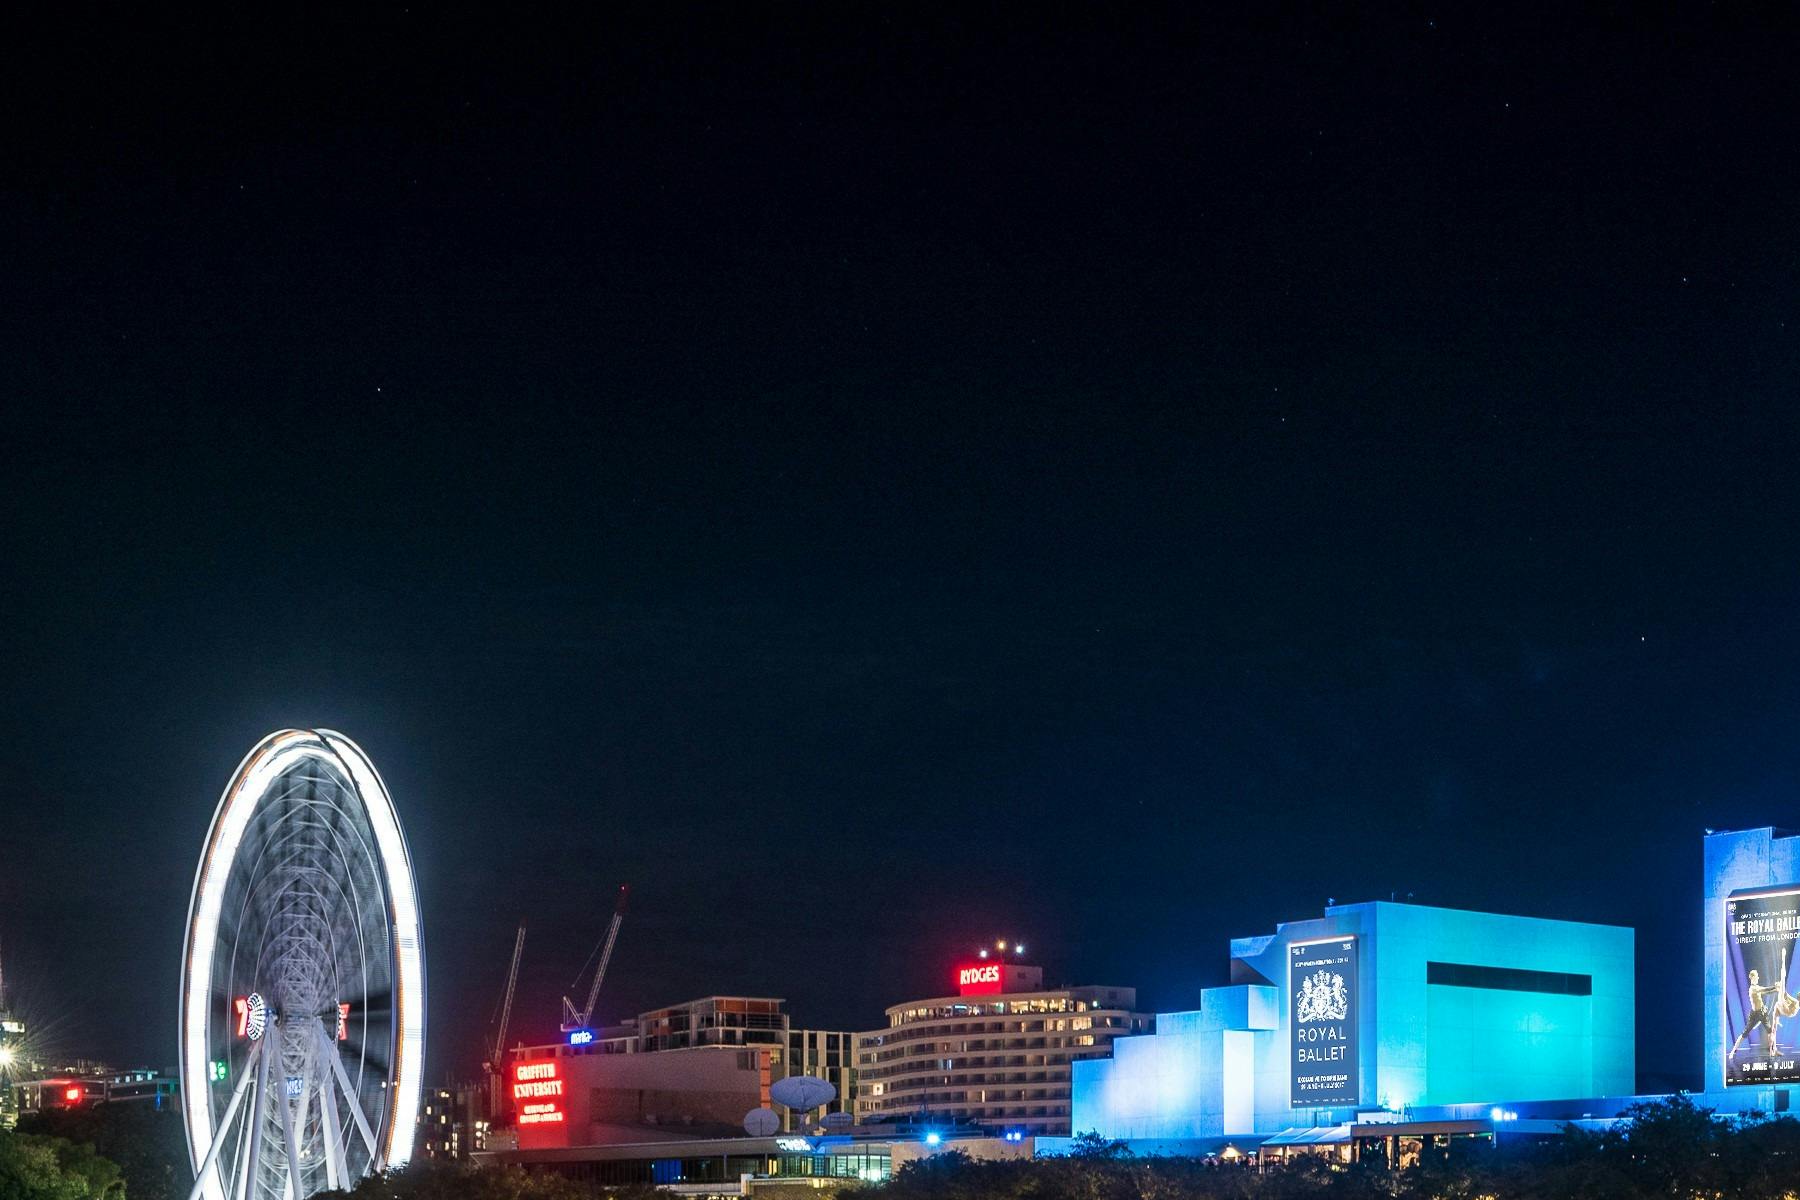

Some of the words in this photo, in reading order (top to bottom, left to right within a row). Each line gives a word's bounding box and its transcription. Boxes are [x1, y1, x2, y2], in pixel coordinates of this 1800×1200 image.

[1730, 921, 1746, 936] THE
[1748, 918, 1774, 935] ROYAL
[1736, 936, 1757, 944] DIRECT
[1758, 934, 1776, 942] FROM
[960, 965, 1000, 985] RYDGES
[1298, 1026, 1347, 1043] ROYAL
[1298, 1046, 1347, 1063] BALLET
[517, 1063, 556, 1081] GRIFFITH
[1752, 1062, 1768, 1071] JUNE
[1780, 1060, 1795, 1070] JULY
[513, 1080, 563, 1099] UNIVERSITY
